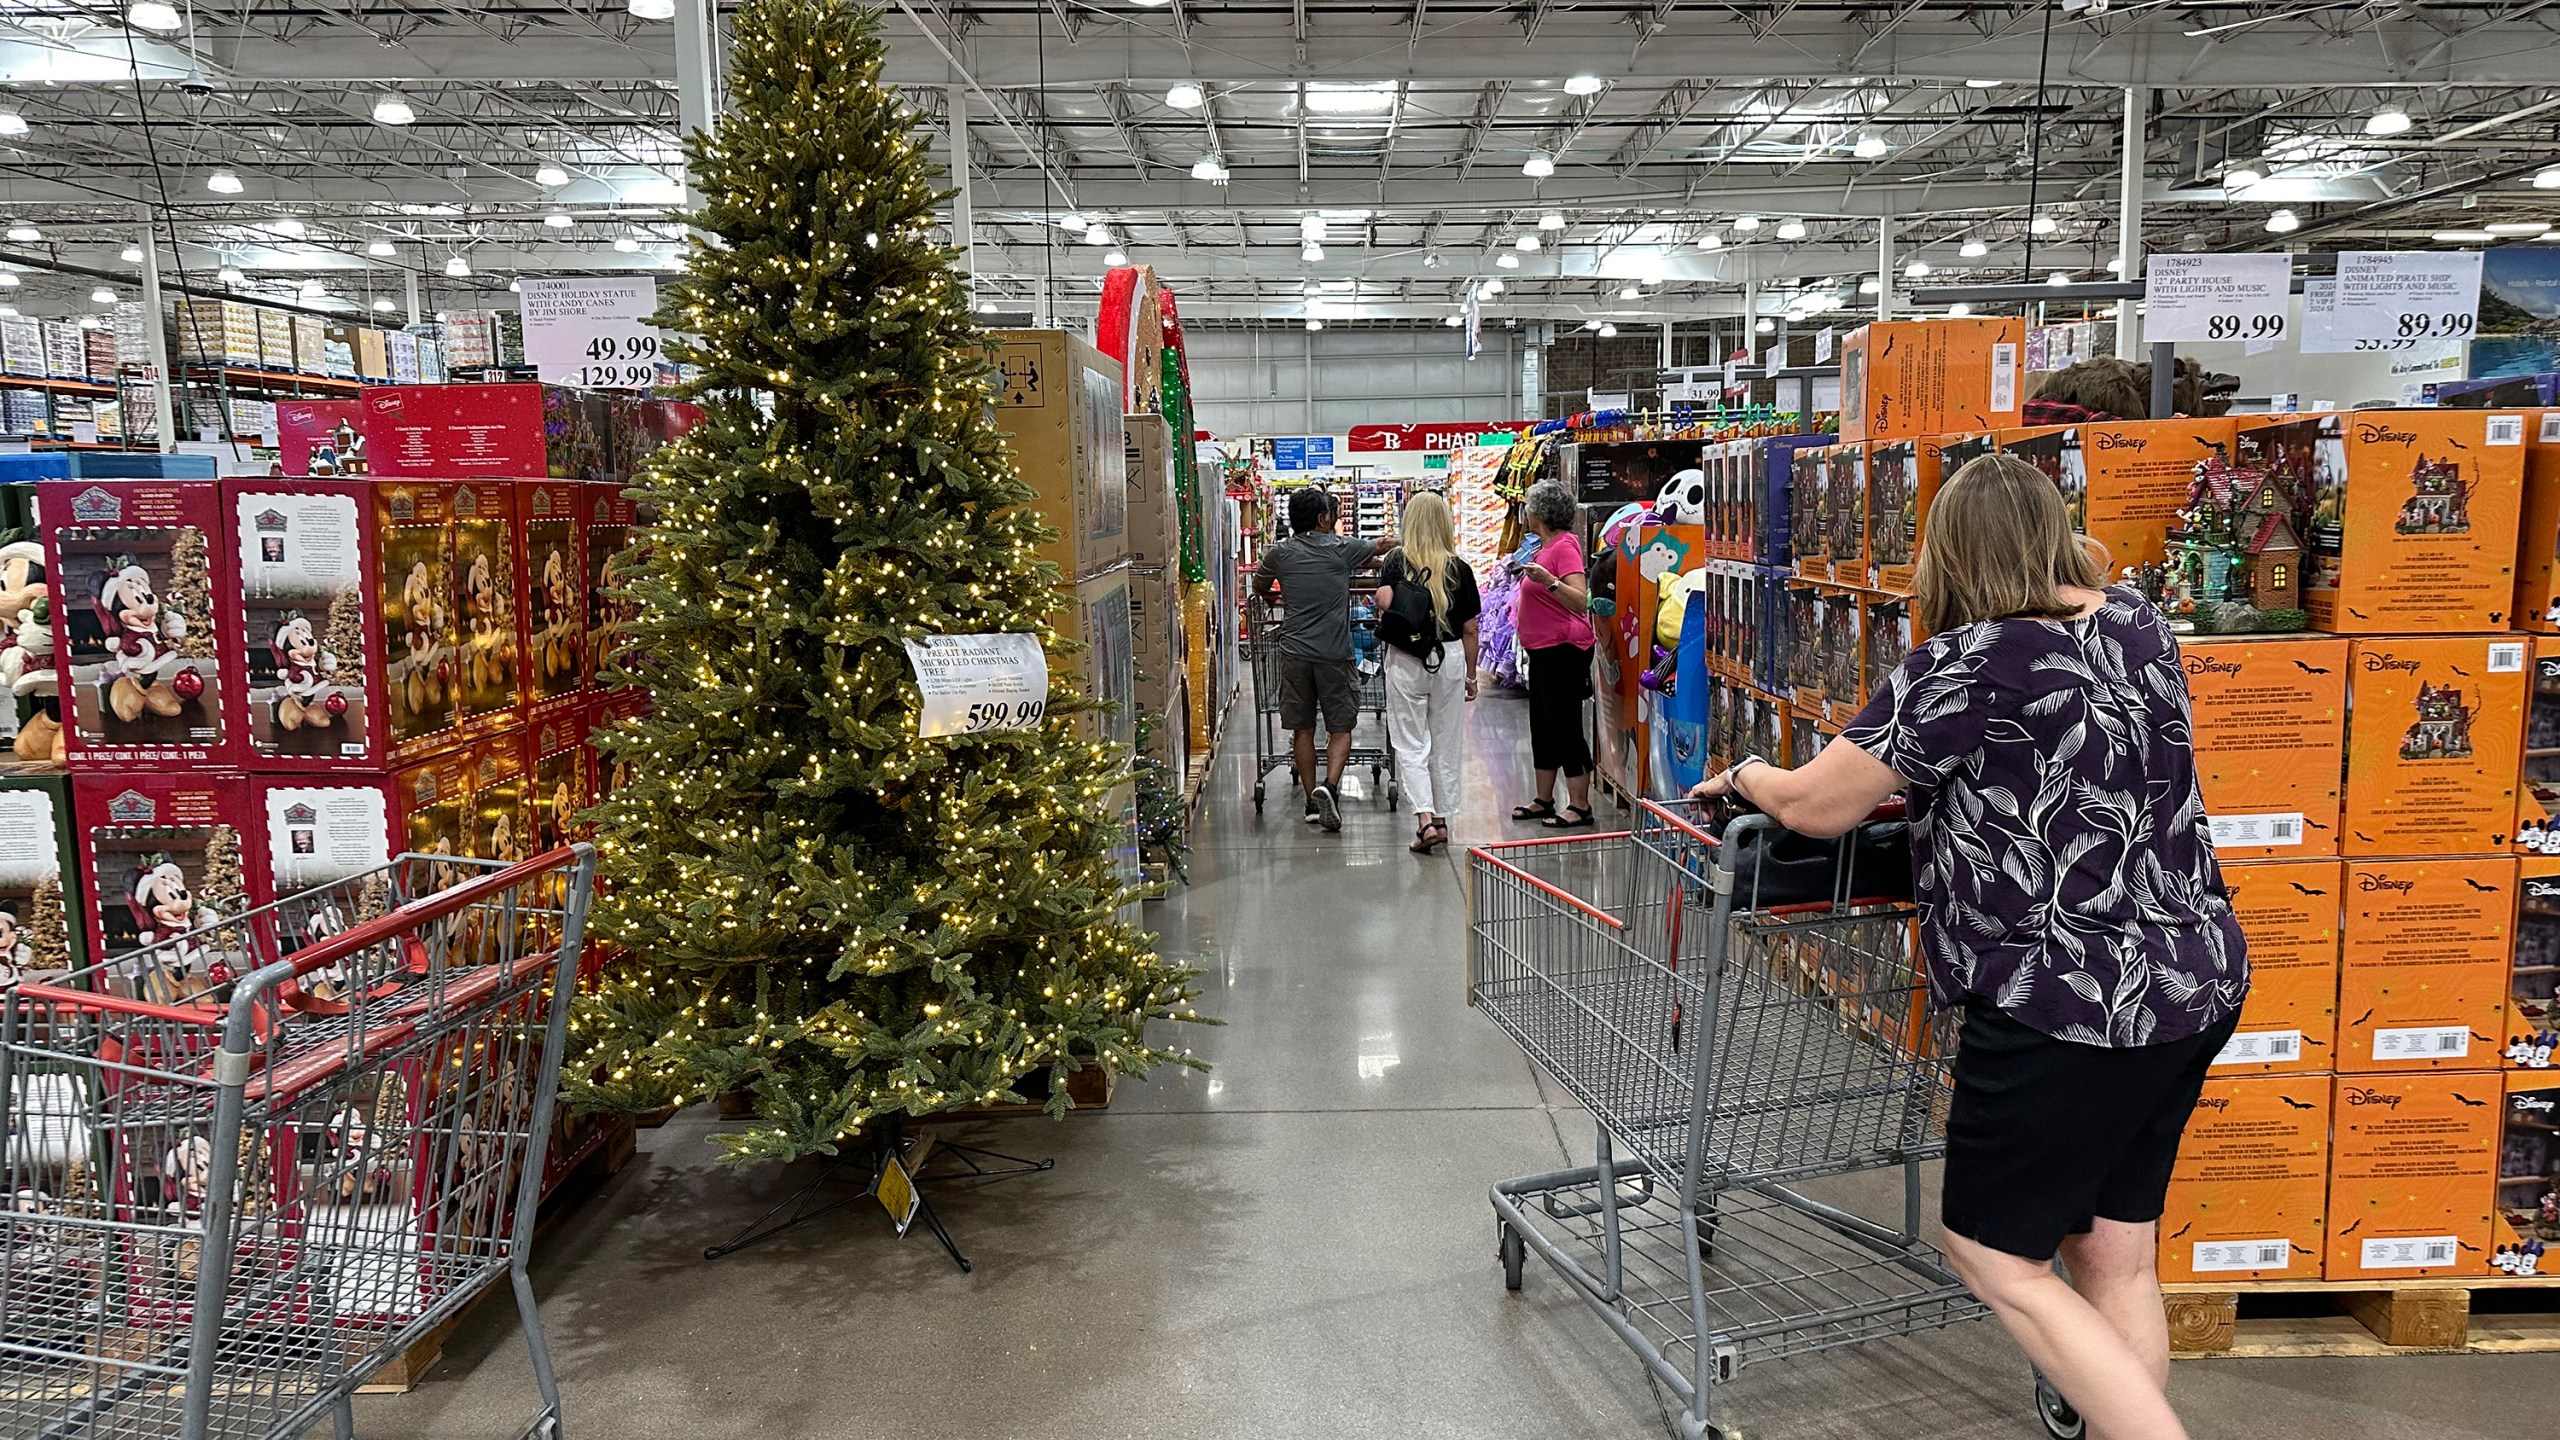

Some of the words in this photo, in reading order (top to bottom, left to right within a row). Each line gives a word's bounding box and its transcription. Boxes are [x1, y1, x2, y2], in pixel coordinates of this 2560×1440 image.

[2166, 258, 2202, 267] 1784923
[2154, 268, 2188, 277] DISNEY
[2344, 266, 2379, 274] DISNEY
[2169, 277, 2199, 285] PARTY
[2202, 276, 2233, 284] HOUSE
[2344, 274, 2393, 282] ANIMATED
[2396, 274, 2429, 282] PIRATE
[2430, 274, 2451, 282] SHIP
[537, 282, 570, 290] 1740001
[2180, 285, 2212, 293] LIGHTS
[2237, 284, 2267, 292] MUSIC
[2344, 283, 2367, 291] WITH
[2370, 283, 2403, 291] LIGHTS
[2428, 282, 2458, 290] MUSIC
[527, 292, 558, 300] DISNEY
[561, 291, 600, 299] HOLIDAY
[602, 290, 636, 298] STATUE
[553, 300, 583, 308] CANDY
[586, 299, 615, 307] CANES
[542, 308, 556, 316] JIM
[2208, 314, 2283, 339] 89.99
[2398, 313, 2473, 337] 89.99
[586, 336, 657, 361] 49.99
[580, 366, 652, 386] 129.99
[1691, 389, 1720, 399] 31.99
[1874, 394, 1893, 435] Disney
[2357, 423, 2417, 449] Disney
[2093, 431, 2147, 453] Disney
[927, 648, 959, 657] PRE-LIT
[962, 647, 1000, 656] RADIANT
[920, 658, 950, 667] MICRO
[952, 658, 970, 666] LED
[971, 656, 1019, 666] CHRISTMAS
[2182, 655, 2242, 679] Disney
[2361, 652, 2420, 676] Disney
[923, 668, 947, 677] TREE
[965, 700, 1043, 731] 599.99
[2355, 872, 2414, 896] Disney
[2343, 1087, 2402, 1110] Disney
[2512, 1095, 2555, 1113] Disney
[2197, 1097, 2229, 1114] sney
